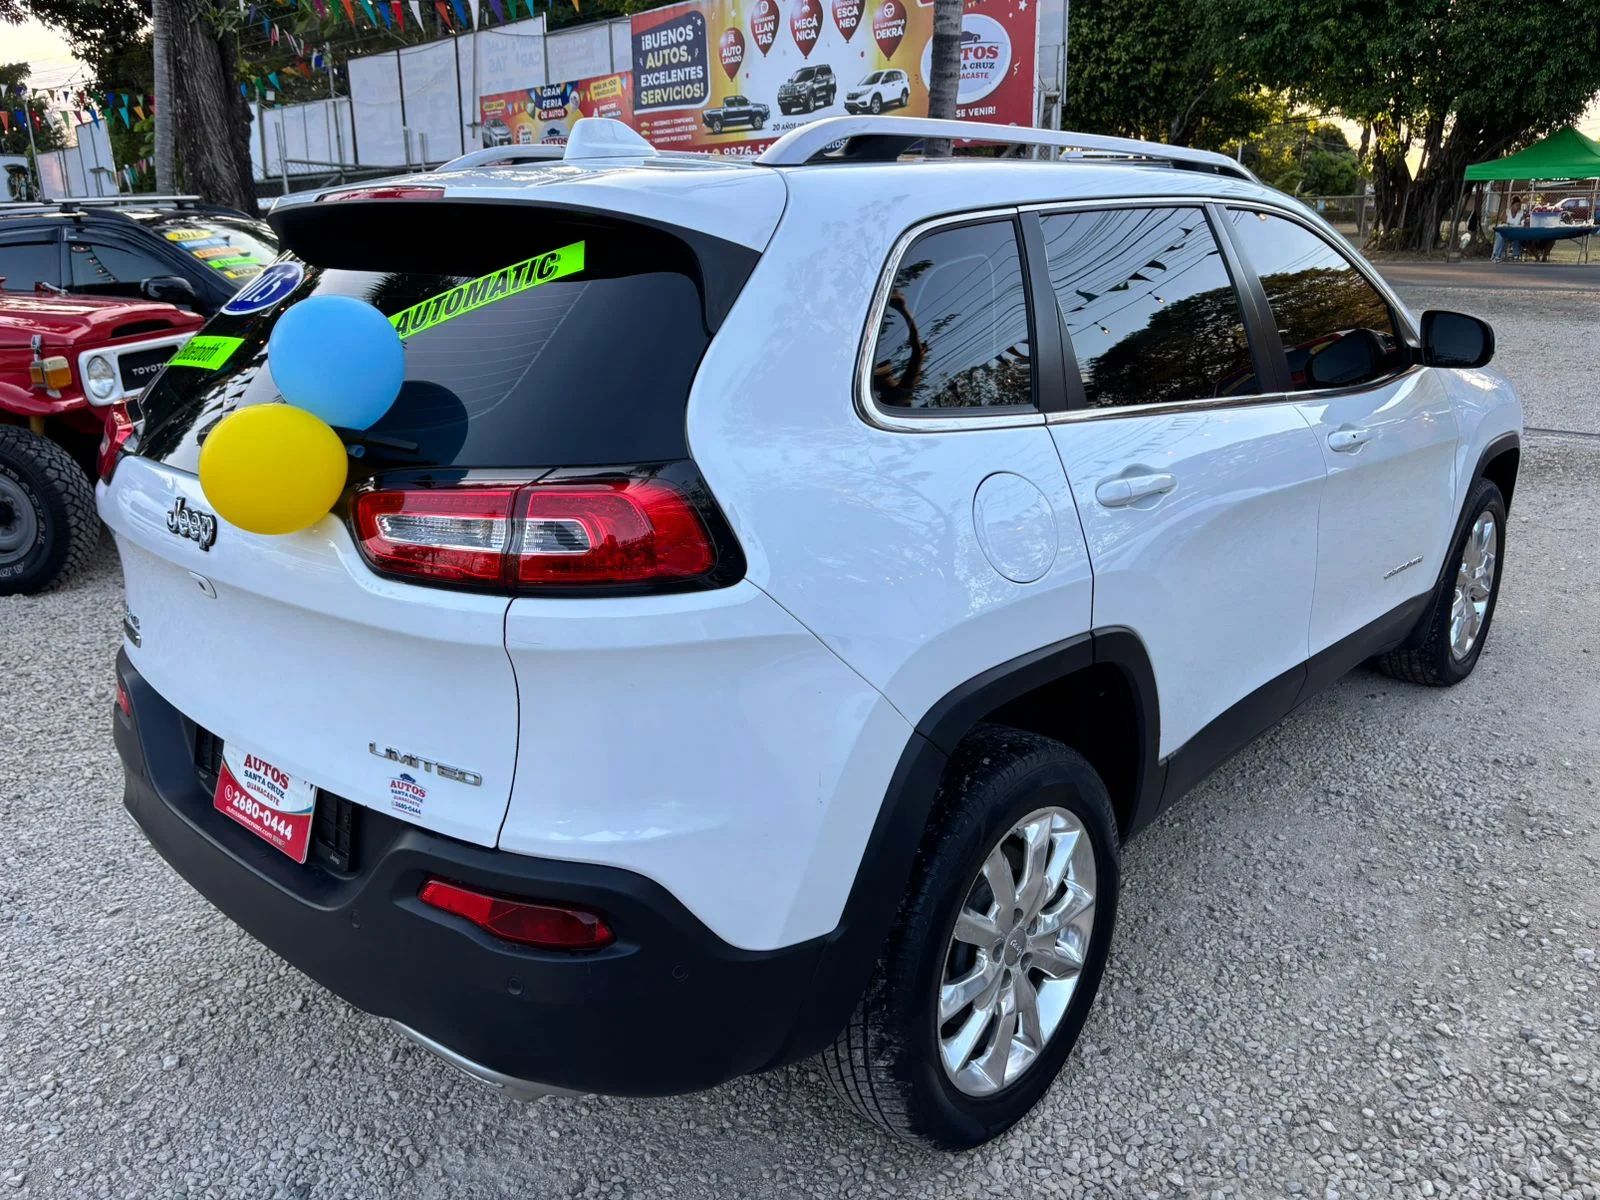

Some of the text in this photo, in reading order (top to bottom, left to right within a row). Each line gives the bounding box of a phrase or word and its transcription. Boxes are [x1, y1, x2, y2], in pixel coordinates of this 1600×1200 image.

[836, 7, 859, 19] ESCA
[755, 22, 774, 34] LLAN
[794, 14, 818, 30] MECÁ
[839, 17, 856, 29] NEO
[641, 24, 694, 51] ¡BUENOS
[757, 34, 773, 46] TAS
[796, 29, 817, 42] NICA
[875, 26, 904, 40] DEKRA
[646, 45, 692, 70] AUTOS,
[722, 45, 742, 57] AUTO
[961, 45, 999, 61] TOS
[640, 65, 704, 88] EXCELENTES
[960, 72, 989, 80] ACASTE
[542, 86, 561, 97] GRAN
[640, 82, 705, 106] SERVICIOS!
[542, 98, 562, 109] FERIA
[968, 106, 996, 117] VENIR!
[548, 109, 565, 118] AUTOS
[235, 272, 296, 303] 015
[395, 252, 562, 336] AUTOMATIC
[131, 362, 164, 376] TOYOT
[166, 496, 218, 553] Jeep
[243, 753, 290, 790] AUTOS
[368, 740, 482, 787] LIMITED
[244, 769, 286, 800] SANTA CRUZ
[390, 779, 427, 798] AUTOS
[232, 790, 294, 841] 2680-0444
